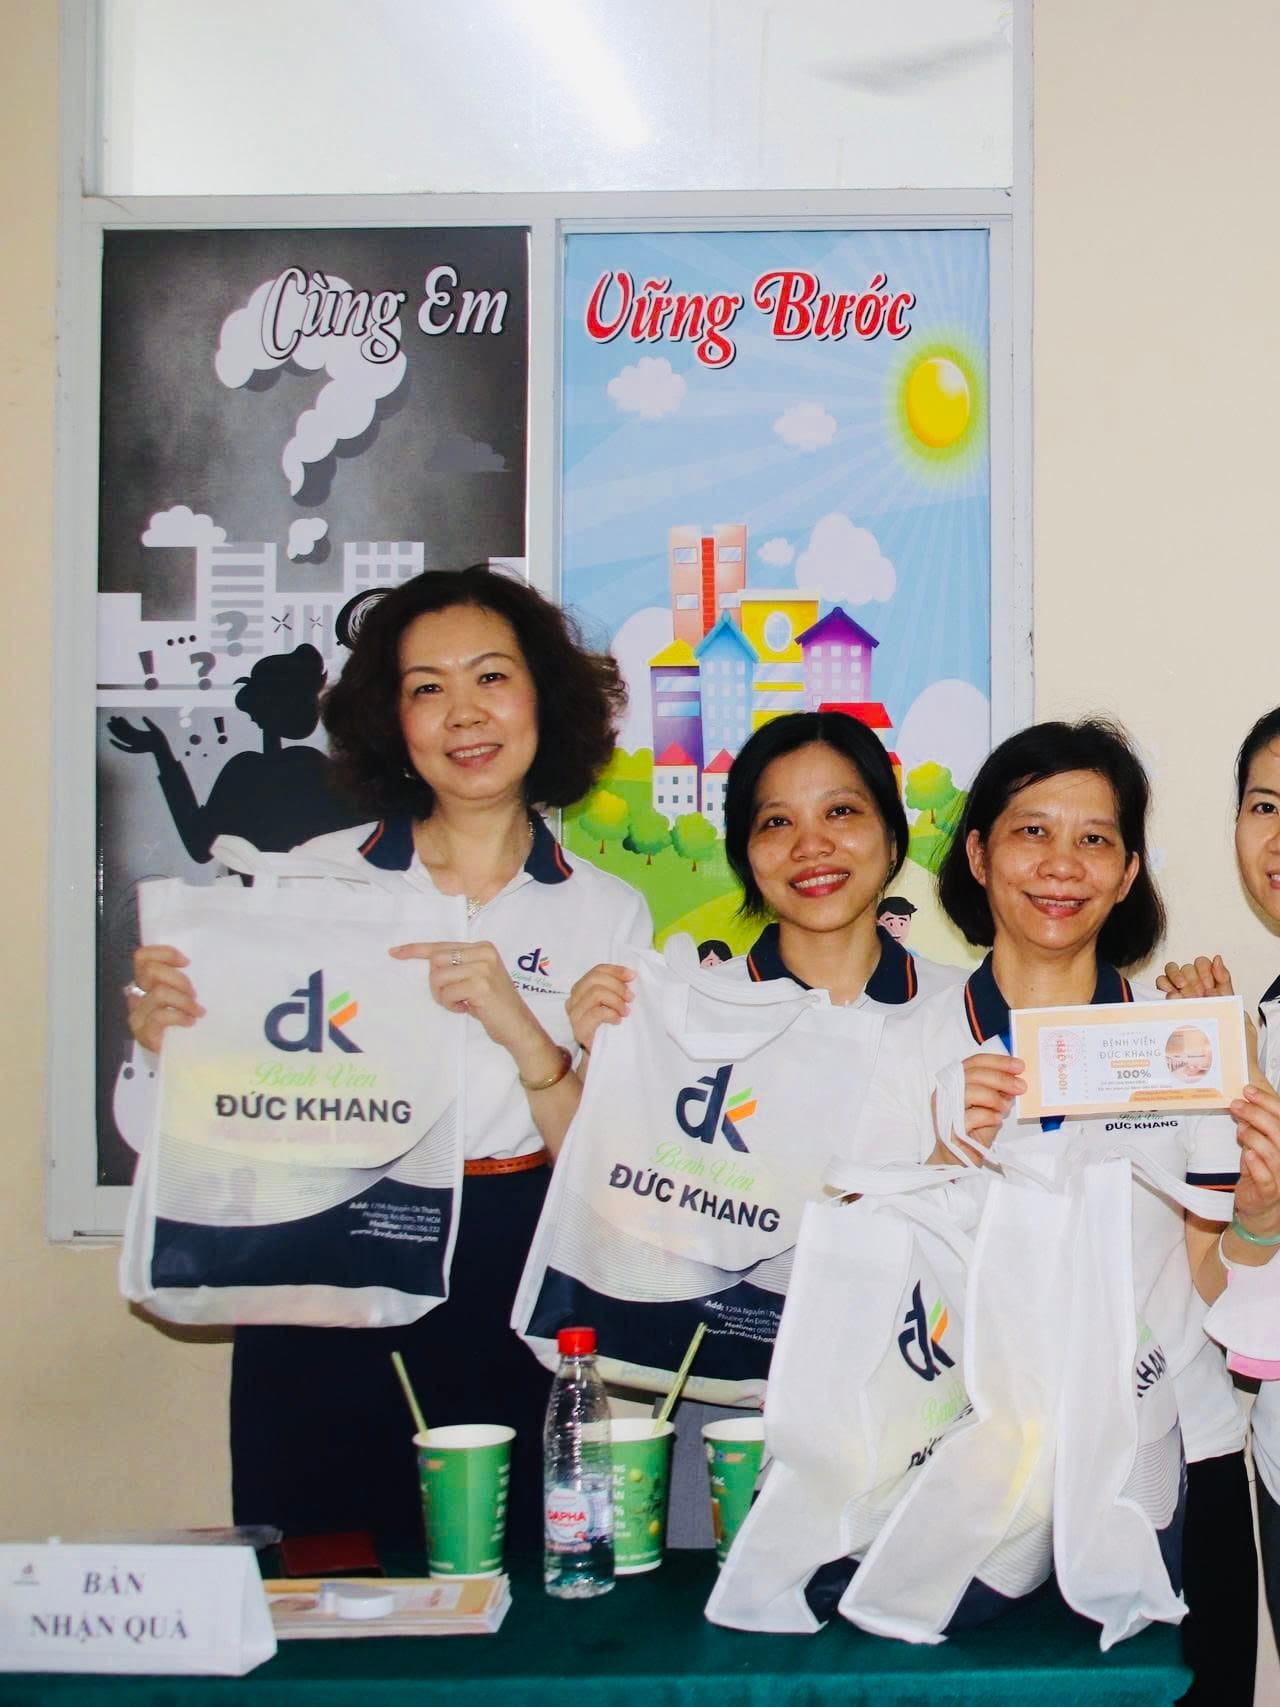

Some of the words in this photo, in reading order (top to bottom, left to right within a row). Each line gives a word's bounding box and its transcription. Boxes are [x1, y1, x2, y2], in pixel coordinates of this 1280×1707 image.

[261, 266, 406, 364] Cùng
[417, 265, 510, 335] Em
[585, 271, 744, 369] Vững
[753, 269, 916, 341] Bước
[1116, 1069, 1152, 1080] 100%
[215, 1091, 287, 1120] ĐỨC
[296, 1098, 412, 1124] KHANG
[1134, 1120, 1179, 1129] KHANG
[609, 1163, 675, 1203] ĐỨC
[679, 1183, 780, 1233] KHANG
